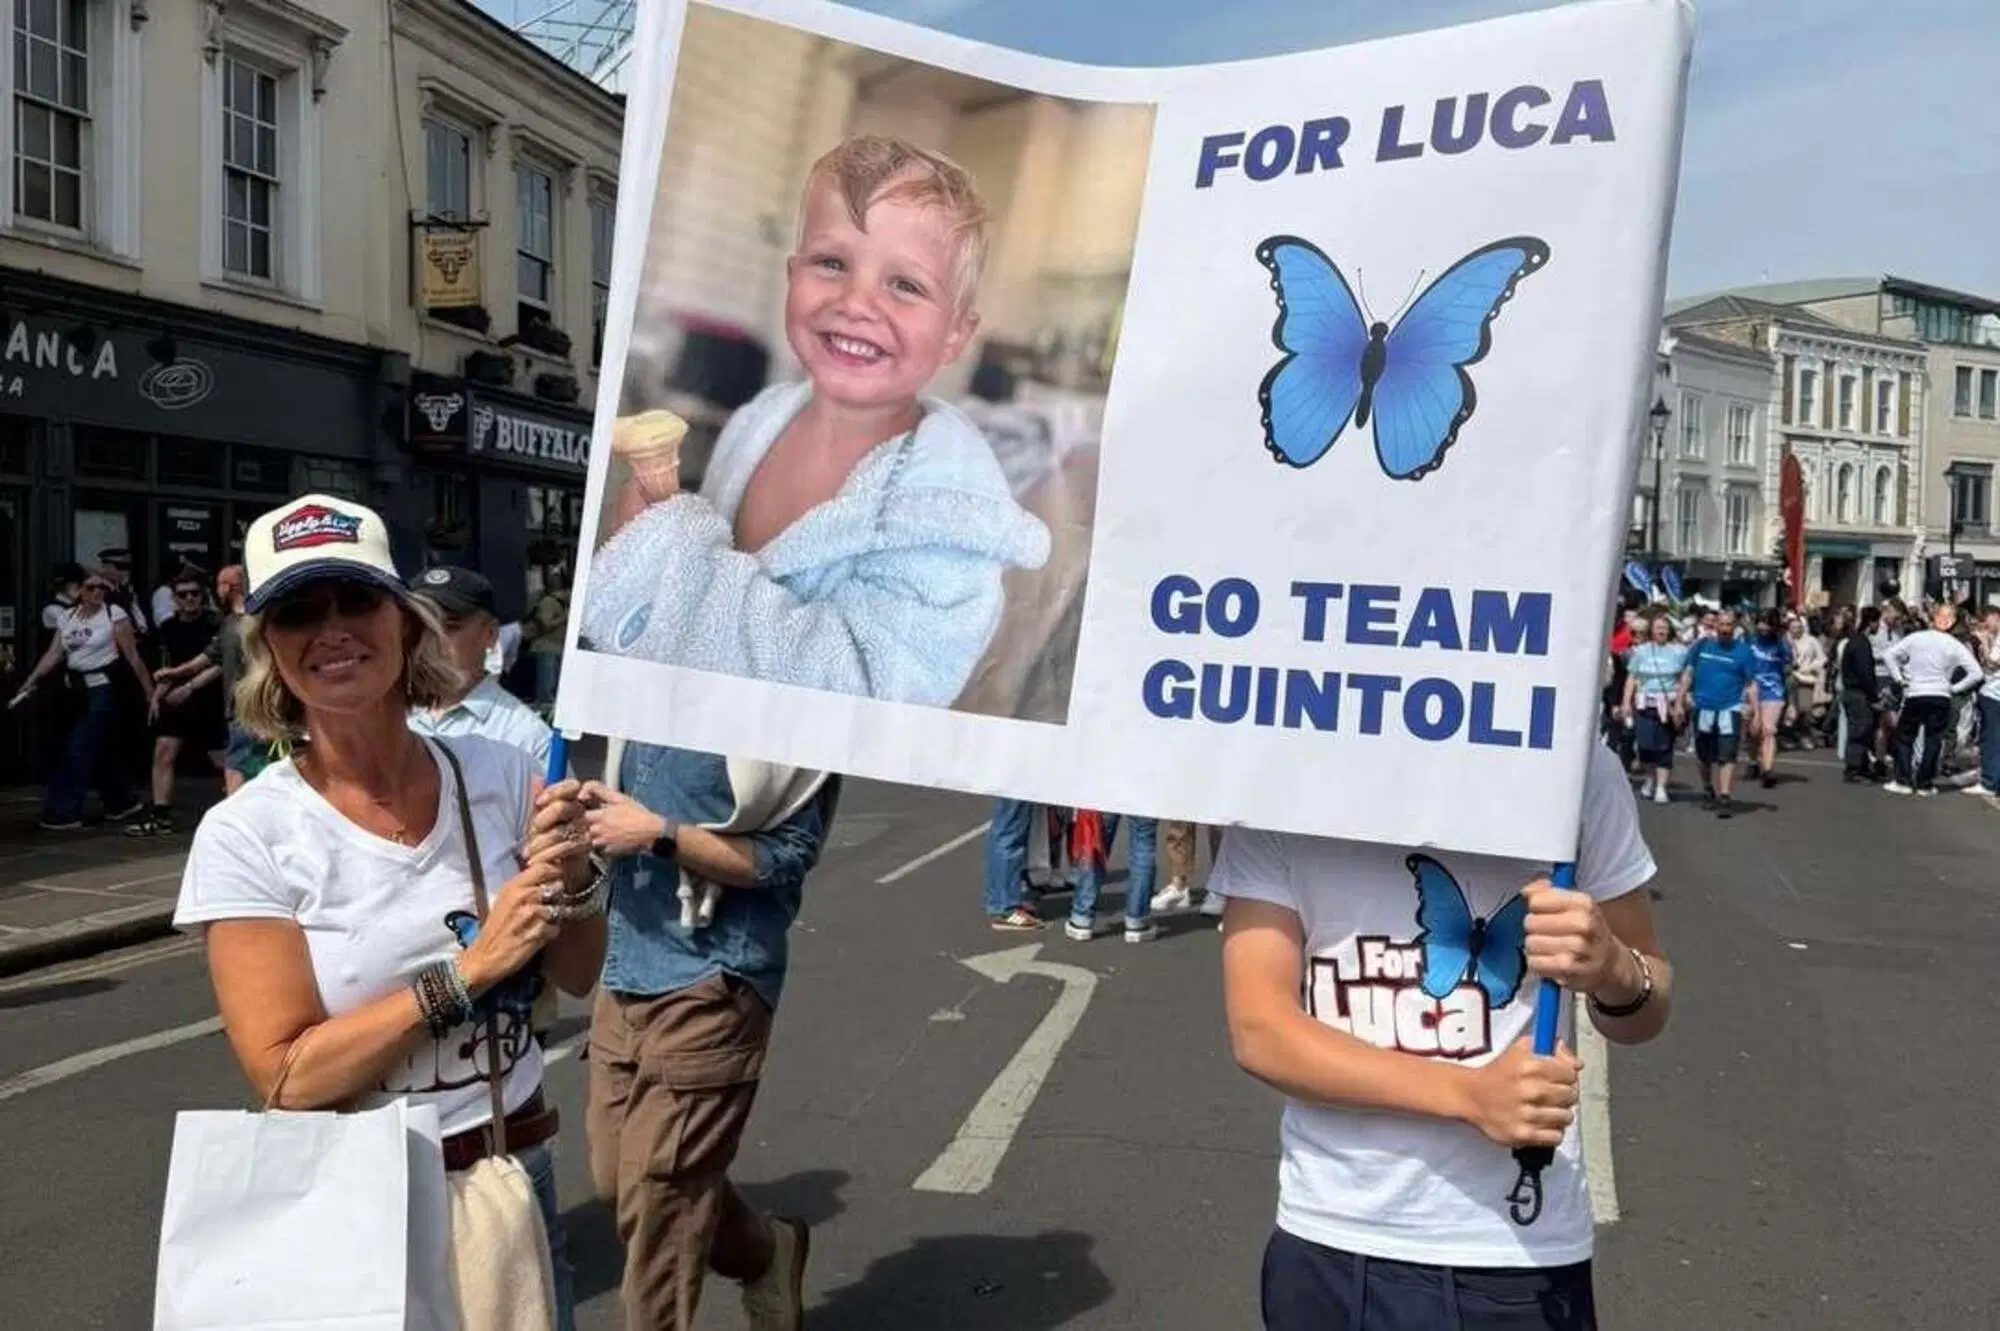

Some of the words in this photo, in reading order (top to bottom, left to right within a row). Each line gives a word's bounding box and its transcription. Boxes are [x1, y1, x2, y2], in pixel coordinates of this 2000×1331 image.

[1195, 115, 1351, 189] FOR
[1374, 79, 1616, 163] LUCA
[1150, 574, 1260, 638] GO
[1290, 581, 1553, 655] TEAM
[1142, 658, 1557, 750] GUINTOLI
[1357, 936, 1425, 980] For
[1311, 954, 1491, 1057] Luca
